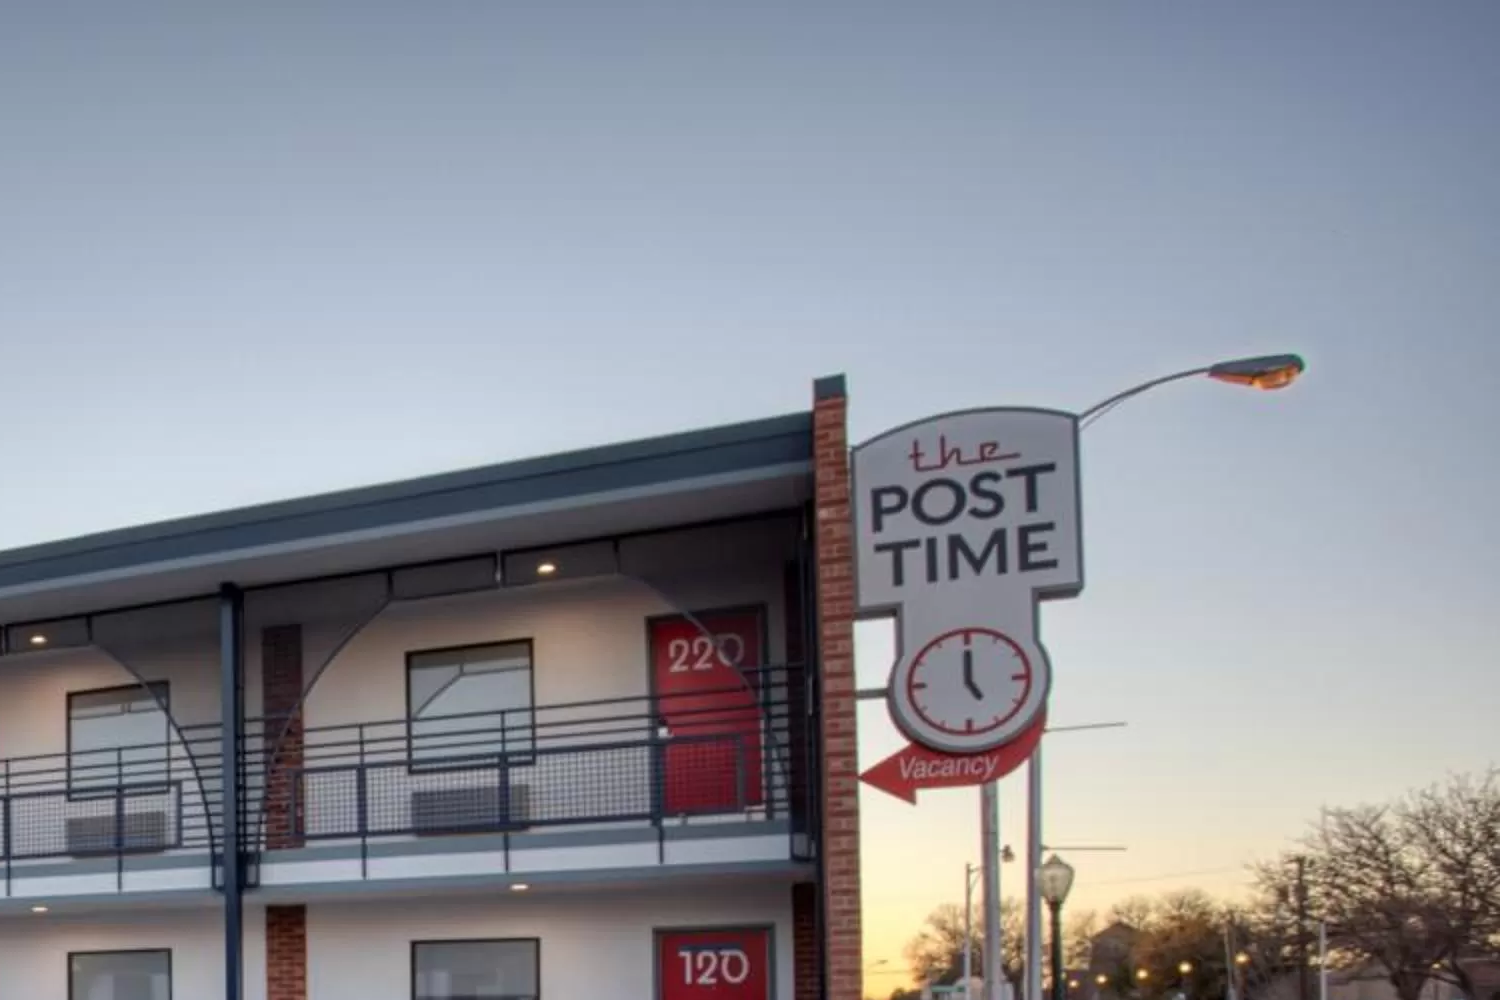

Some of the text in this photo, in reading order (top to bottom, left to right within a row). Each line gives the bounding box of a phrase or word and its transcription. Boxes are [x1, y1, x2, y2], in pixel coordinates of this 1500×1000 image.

[908, 435, 1021, 472] the
[870, 462, 1056, 533] POST
[873, 522, 1059, 588] TIME
[668, 633, 744, 672] 220
[900, 755, 998, 780] Vacancy
[678, 949, 750, 985] 120
